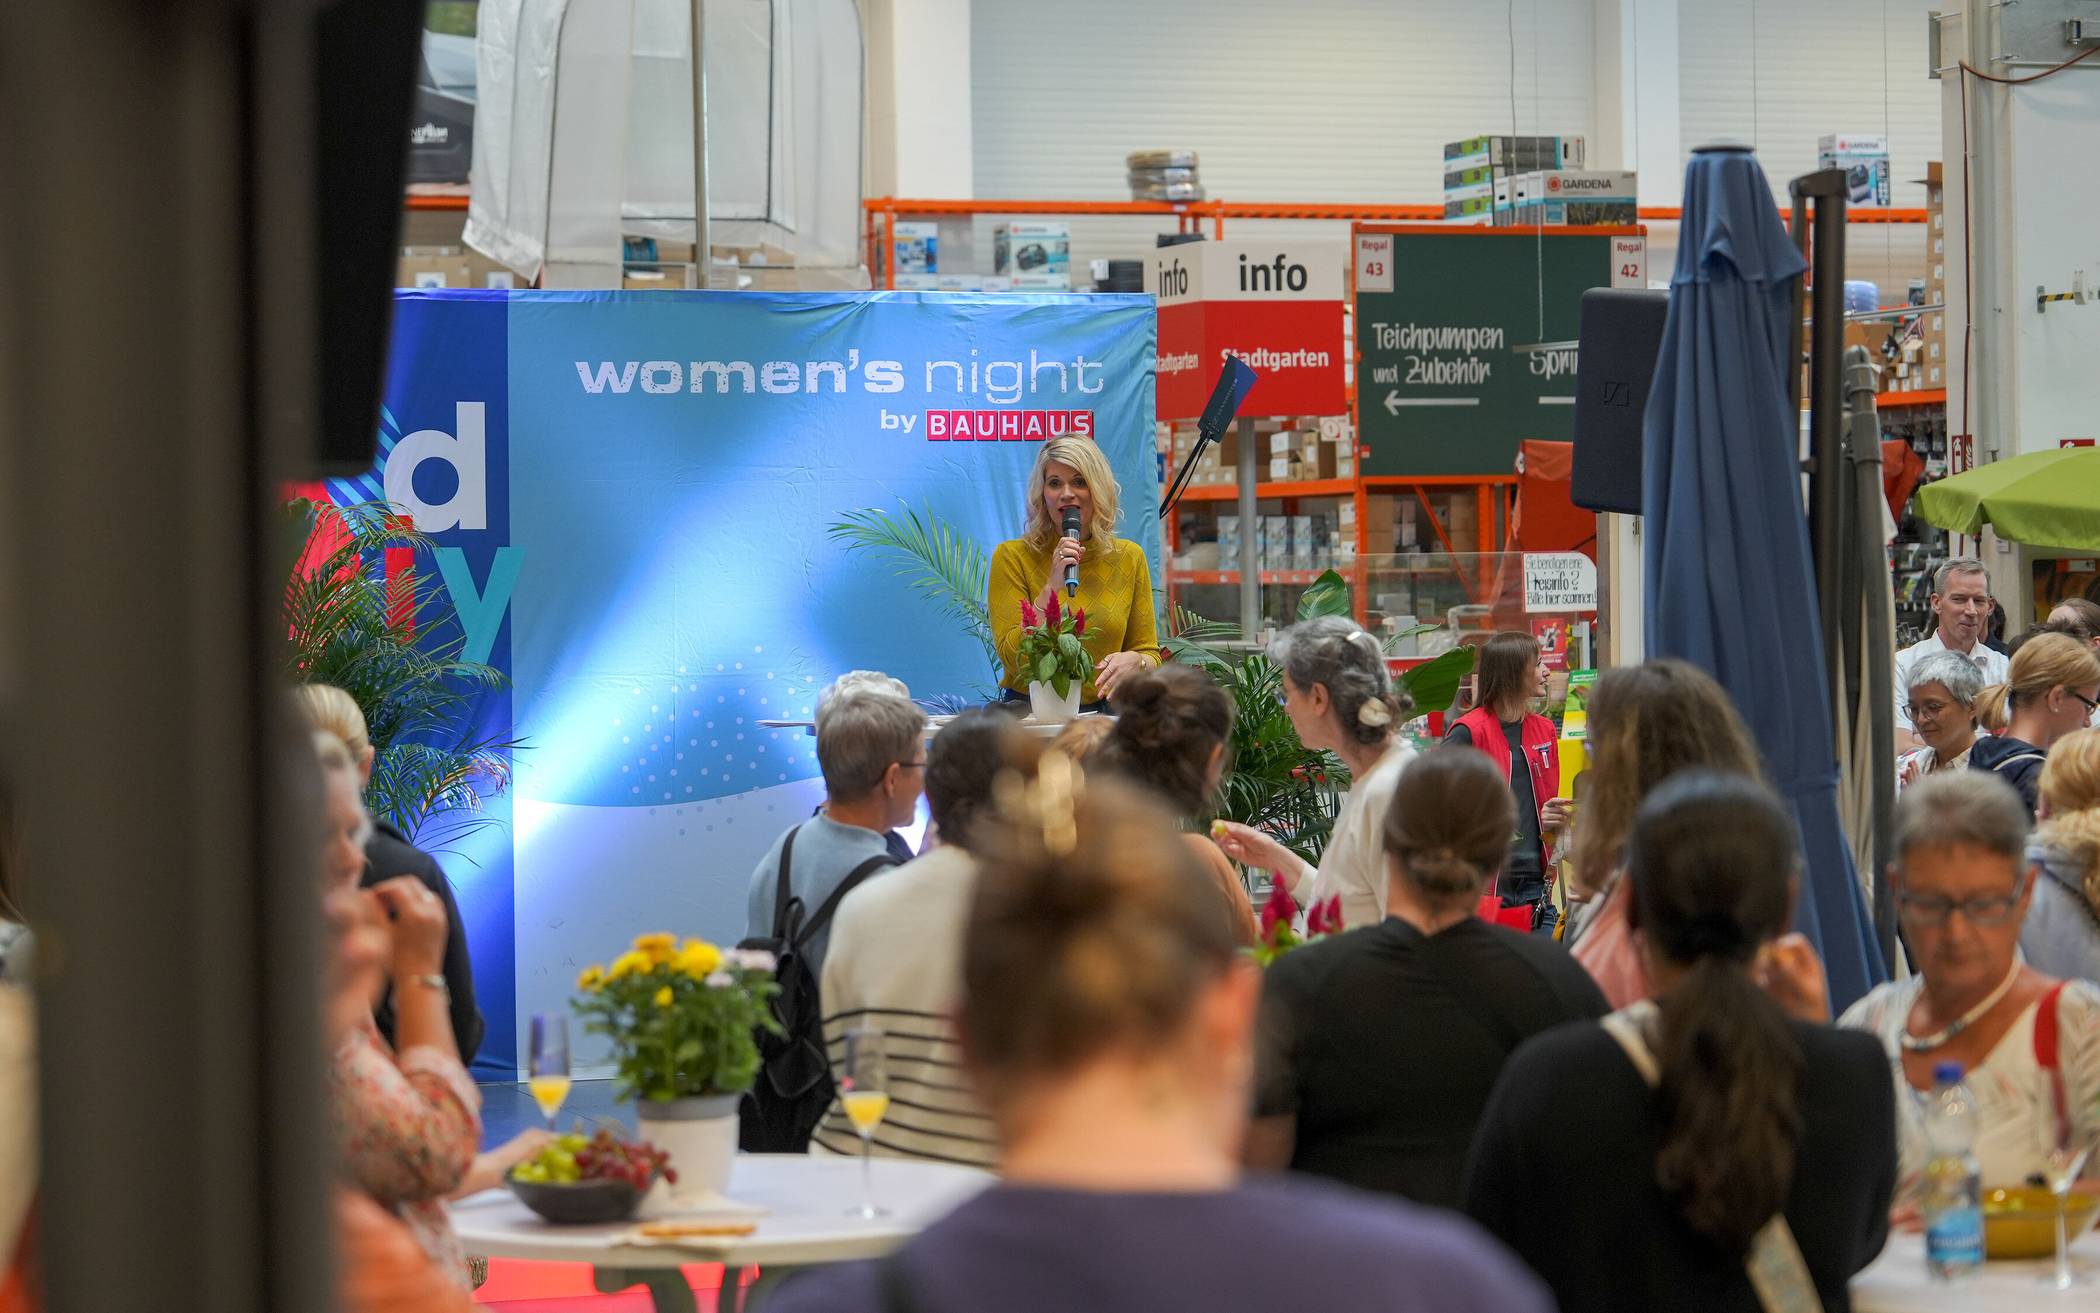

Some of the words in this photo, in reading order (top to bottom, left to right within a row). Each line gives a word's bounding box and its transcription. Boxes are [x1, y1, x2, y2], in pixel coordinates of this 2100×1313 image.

[1562, 178, 1612, 190] GARDENA
[1362, 239, 1388, 252] Regal
[1616, 242, 1642, 254] Regal
[1159, 259, 1188, 298] info
[1239, 253, 1308, 292] info
[1365, 262, 1384, 276] 43
[1621, 264, 1639, 278] 42
[1371, 322, 1504, 355] Teichpumpen
[925, 349, 1104, 403] night
[1373, 364, 1398, 383] und
[1405, 355, 1491, 384] Zubehör
[880, 409, 917, 433] by
[926, 410, 1093, 440] BAUHAUS
